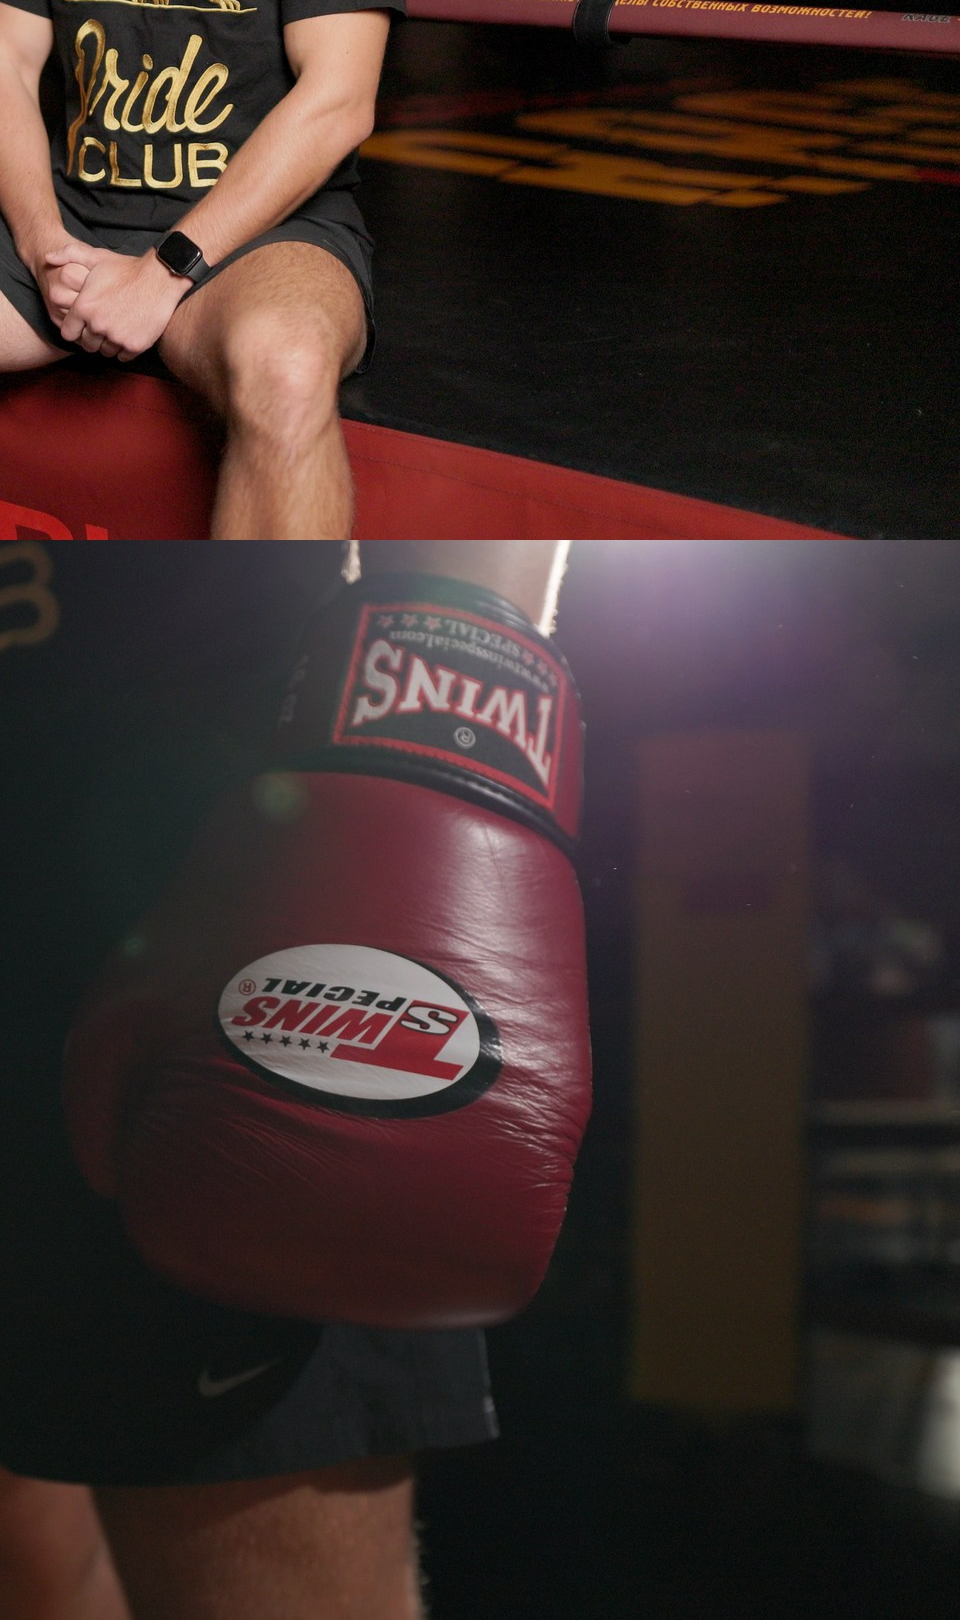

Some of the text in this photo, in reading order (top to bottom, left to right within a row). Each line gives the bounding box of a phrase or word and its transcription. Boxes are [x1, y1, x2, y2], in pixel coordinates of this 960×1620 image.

[67, 18, 235, 178] Pride
[77, 136, 230, 189] CLUB
[447, 618, 522, 660] SPECIAL
[352, 639, 553, 788] TWINS
[230, 995, 470, 1081] TWINS
[261, 978, 458, 1036] SPECIAL
